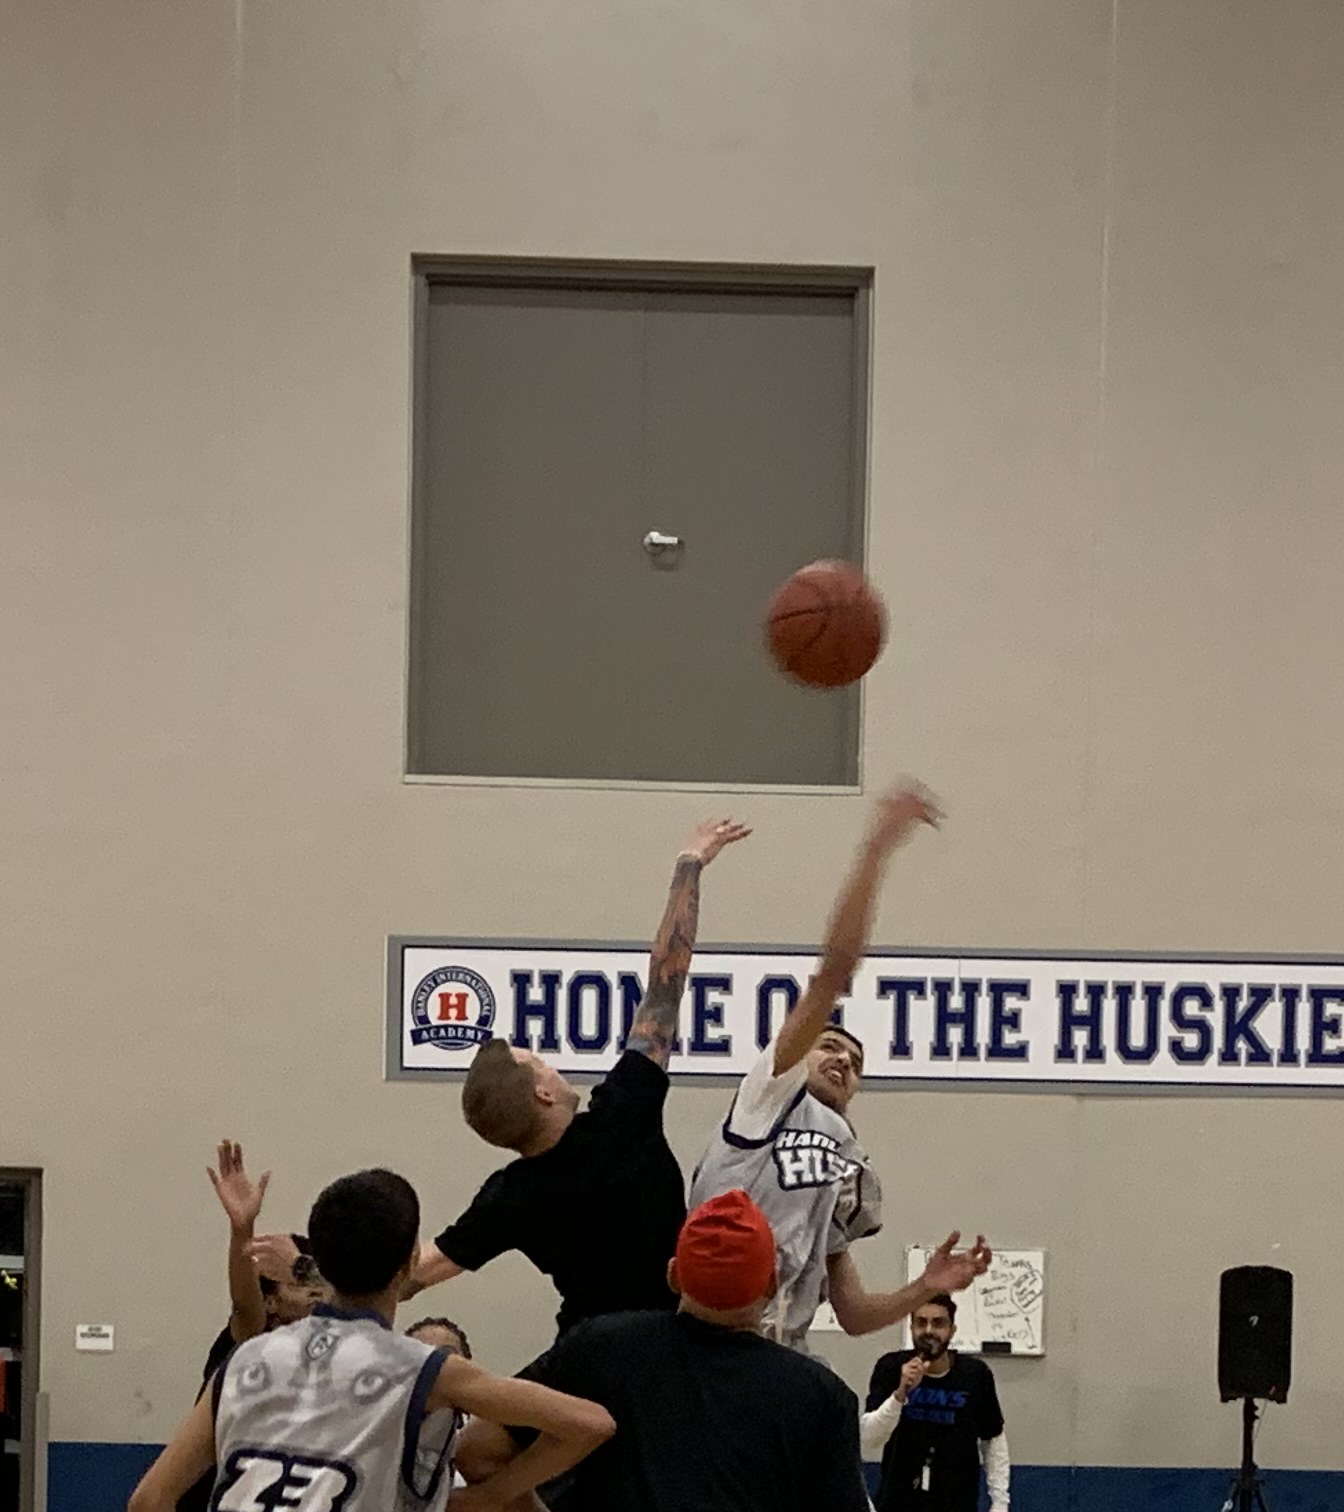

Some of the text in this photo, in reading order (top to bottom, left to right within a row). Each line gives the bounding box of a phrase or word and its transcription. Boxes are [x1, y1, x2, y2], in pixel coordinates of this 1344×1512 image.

[437, 991, 469, 1021] H
[876, 976, 1031, 1062] THE
[421, 1026, 486, 1042] ACADEMY
